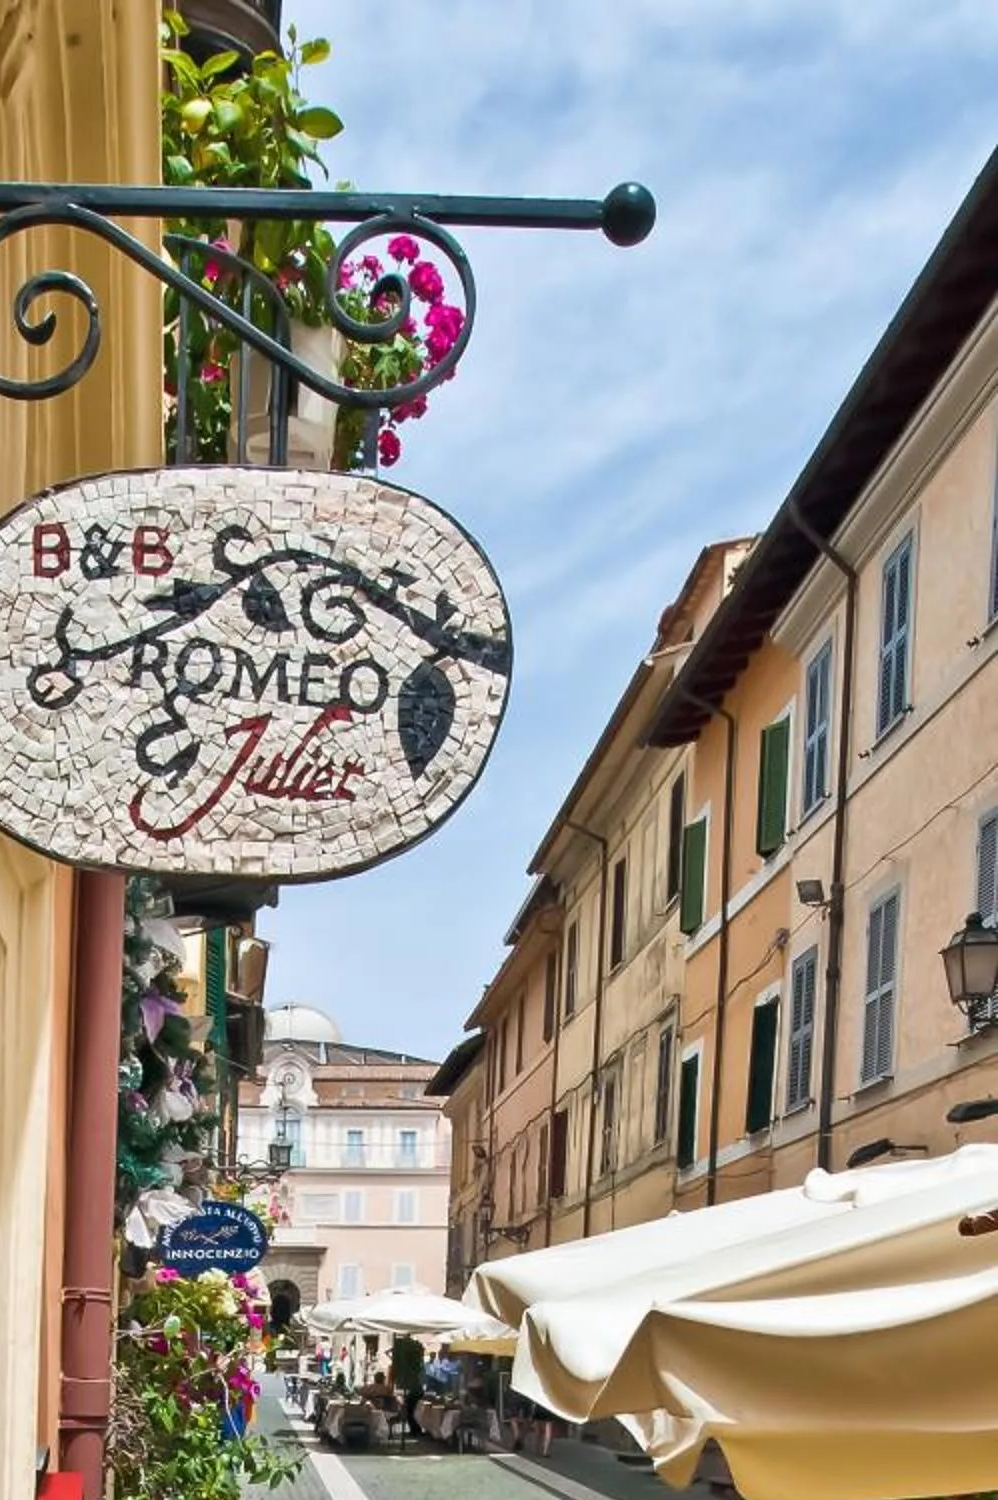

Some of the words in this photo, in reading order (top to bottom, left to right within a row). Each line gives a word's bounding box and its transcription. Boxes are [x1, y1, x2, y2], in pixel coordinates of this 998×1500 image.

[32, 523, 175, 580] B&B
[129, 637, 389, 714] ROMEO
[166, 1249, 259, 1259] INNOCENZIO
